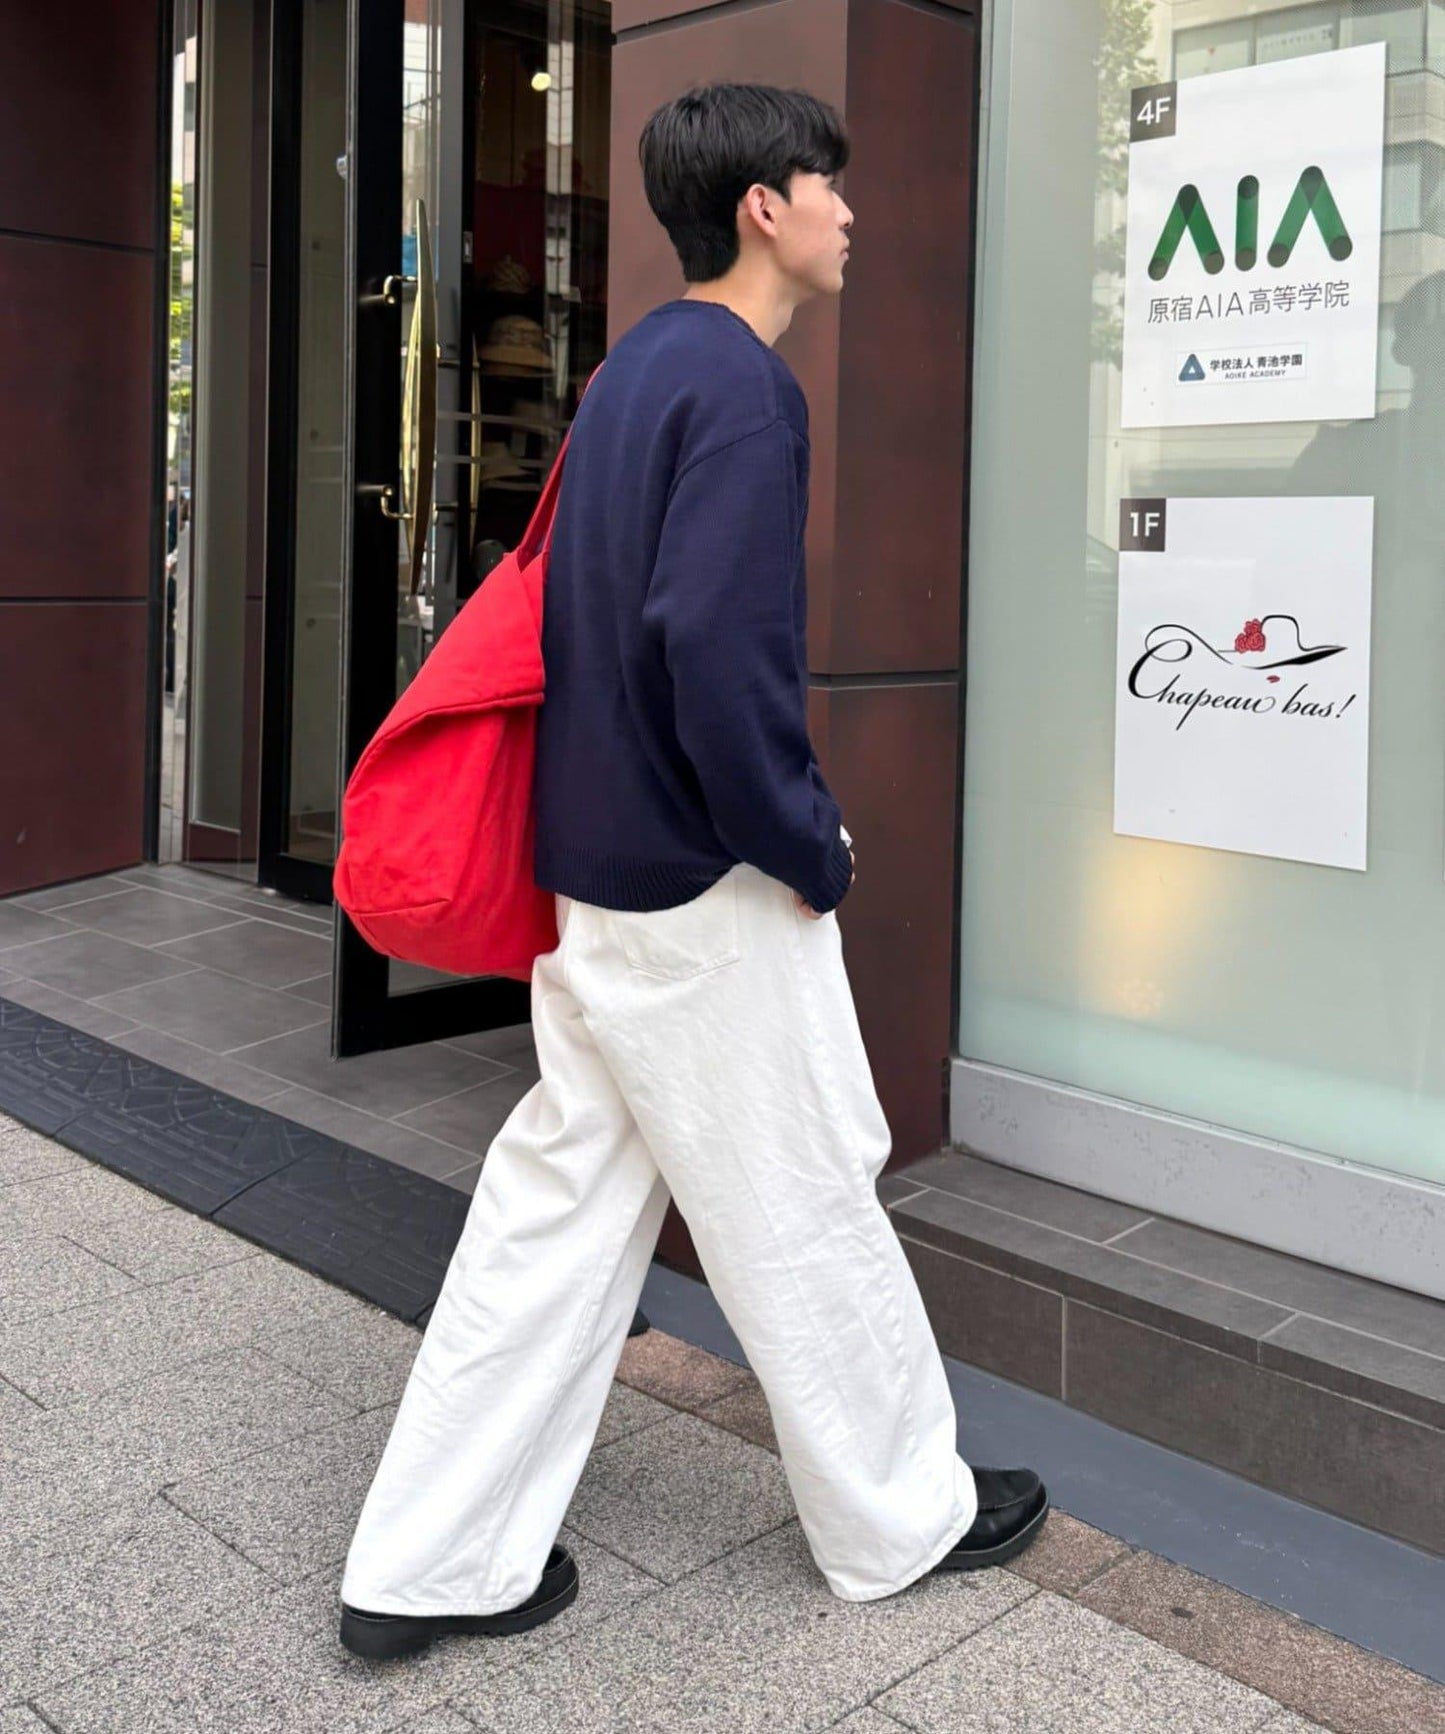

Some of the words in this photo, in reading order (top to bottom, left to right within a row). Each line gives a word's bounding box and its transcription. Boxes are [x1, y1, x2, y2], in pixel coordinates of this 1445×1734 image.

[1137, 97, 1171, 126] 4F
[1148, 165, 1353, 281] AIA
[1147, 279, 1350, 324] 原宿AIA高等学院
[1224, 371, 1247, 380] AOIKE
[1249, 369, 1286, 379] ACADEMY
[1129, 512, 1161, 537] 1F
[1128, 637, 1277, 731] Chapeau
[1281, 683, 1357, 718] bas!
